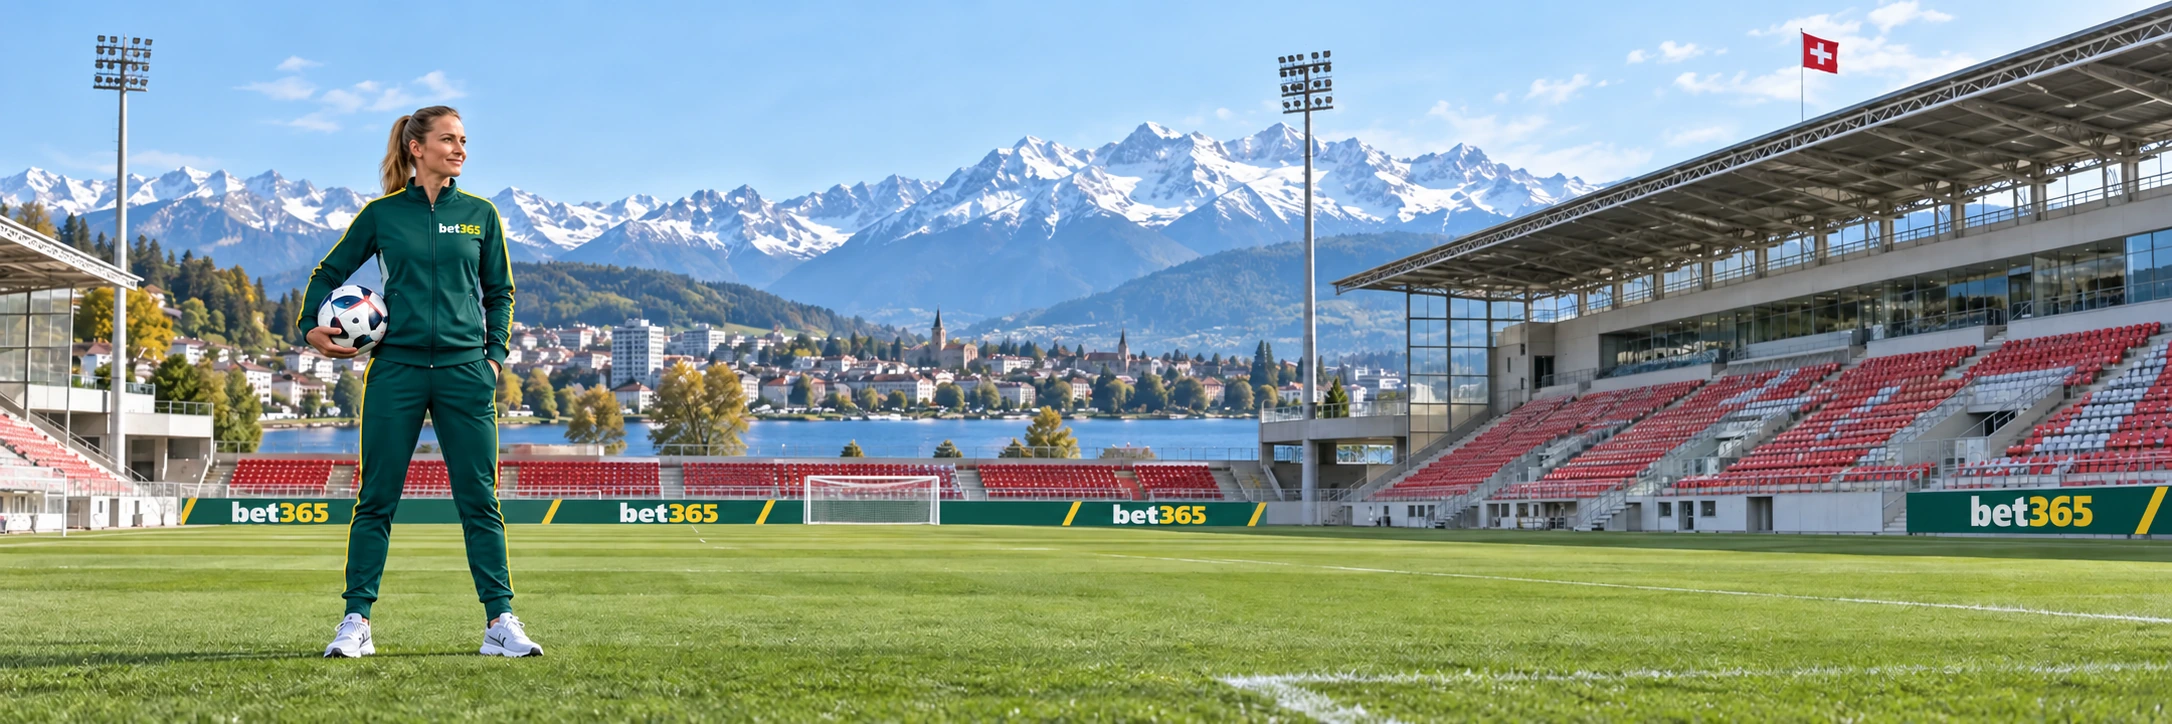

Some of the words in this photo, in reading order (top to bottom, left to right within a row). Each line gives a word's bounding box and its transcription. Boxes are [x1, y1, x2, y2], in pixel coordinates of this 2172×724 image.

[439, 223, 481, 235] bet365
[232, 501, 328, 522] bet365
[620, 503, 718, 523] bet365
[1113, 504, 1206, 524] bet365
[1971, 496, 2093, 526] bet365
